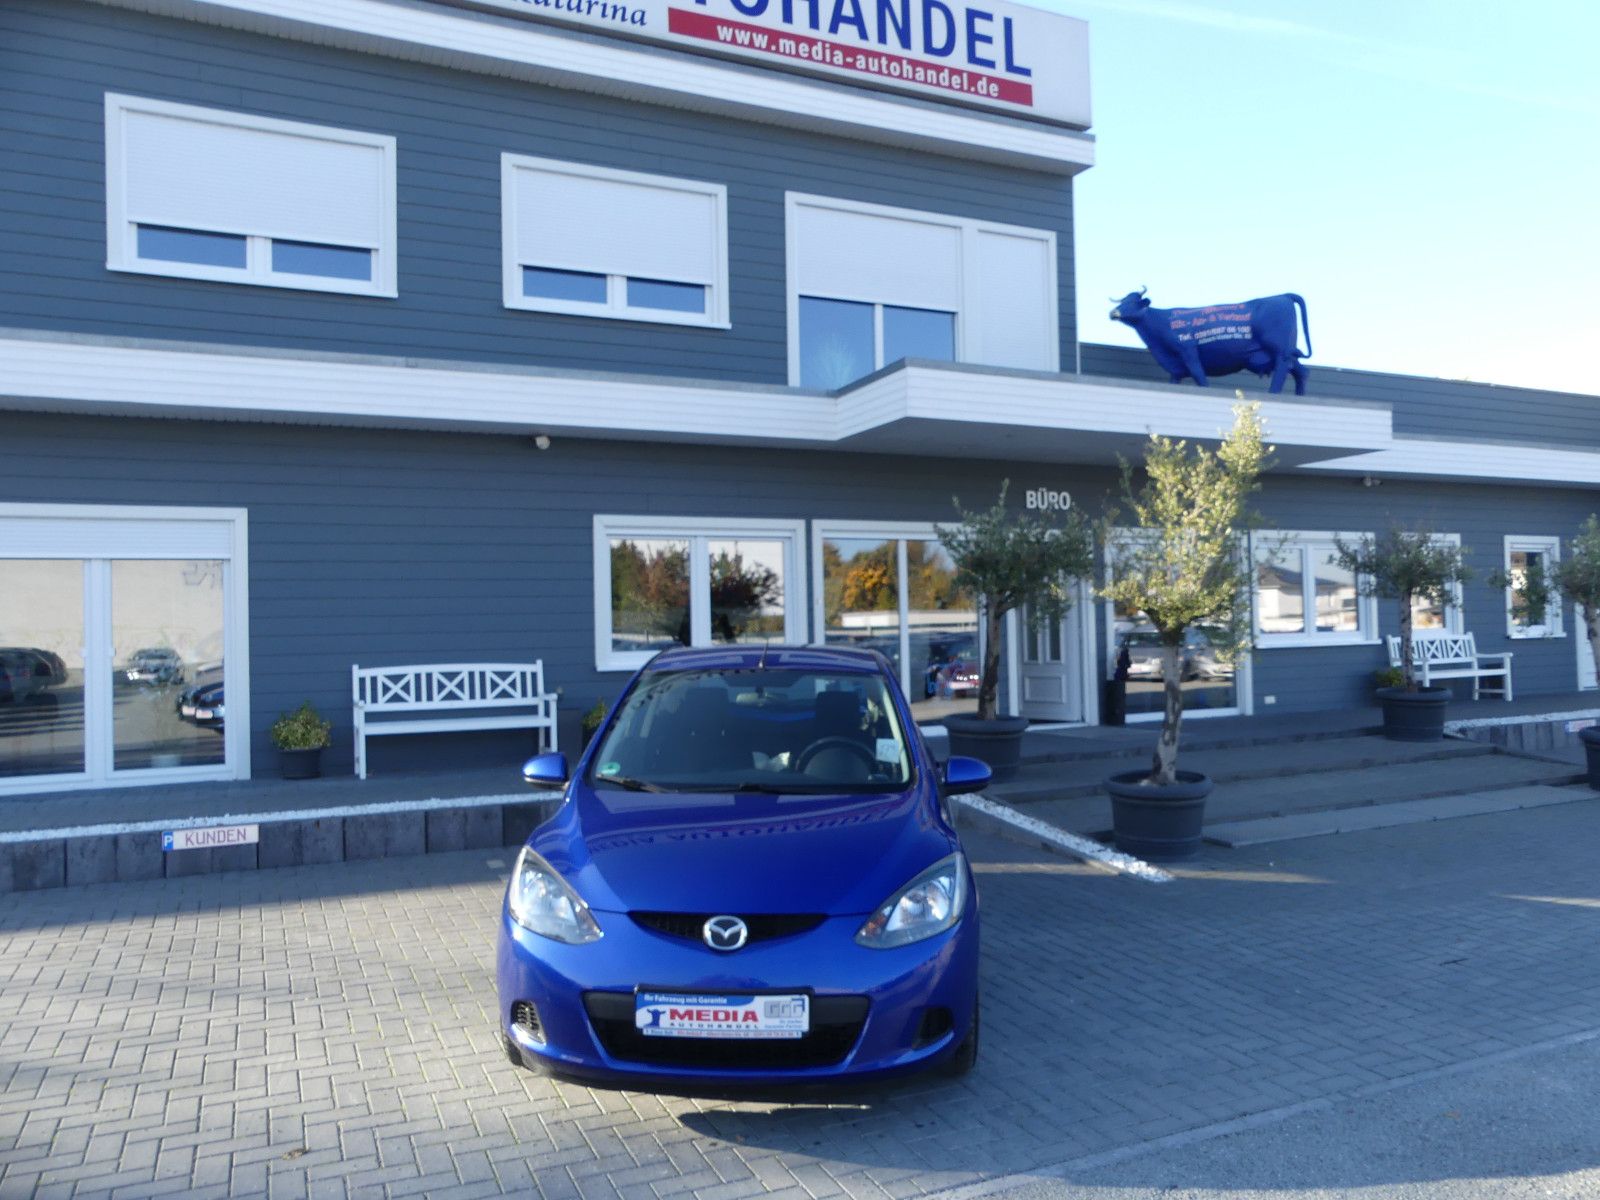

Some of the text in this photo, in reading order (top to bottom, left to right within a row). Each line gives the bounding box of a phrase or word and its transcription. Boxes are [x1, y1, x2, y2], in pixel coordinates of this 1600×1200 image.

[514, 0, 647, 26] arina
[694, 0, 1032, 77] ANDEL
[716, 24, 999, 97] www.media-autohandel.de
[1026, 487, 1071, 510] BÜRO
[164, 827, 247, 847] P KUNDEN
[669, 1008, 759, 1023] MEDIA
